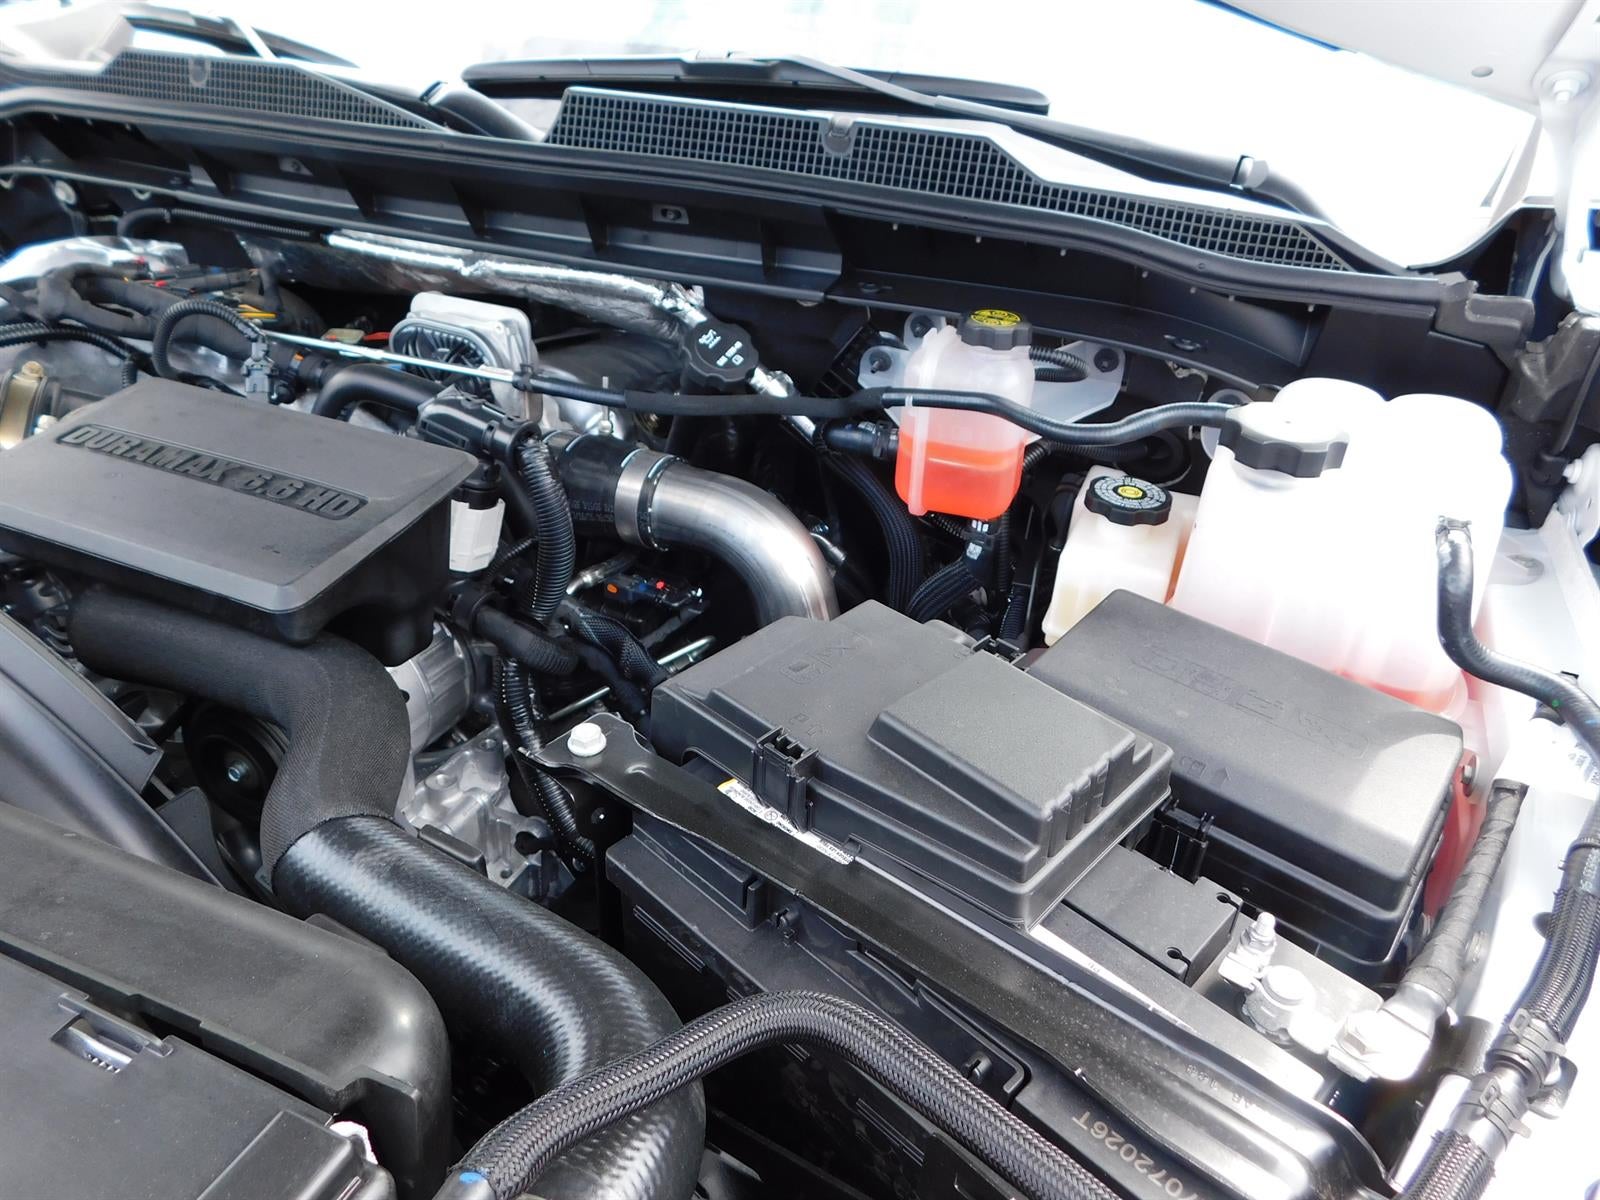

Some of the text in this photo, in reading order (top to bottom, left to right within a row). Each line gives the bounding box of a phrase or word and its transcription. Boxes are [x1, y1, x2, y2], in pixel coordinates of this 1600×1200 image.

[60, 426, 361, 517] DURAMAX 6.6 HD
